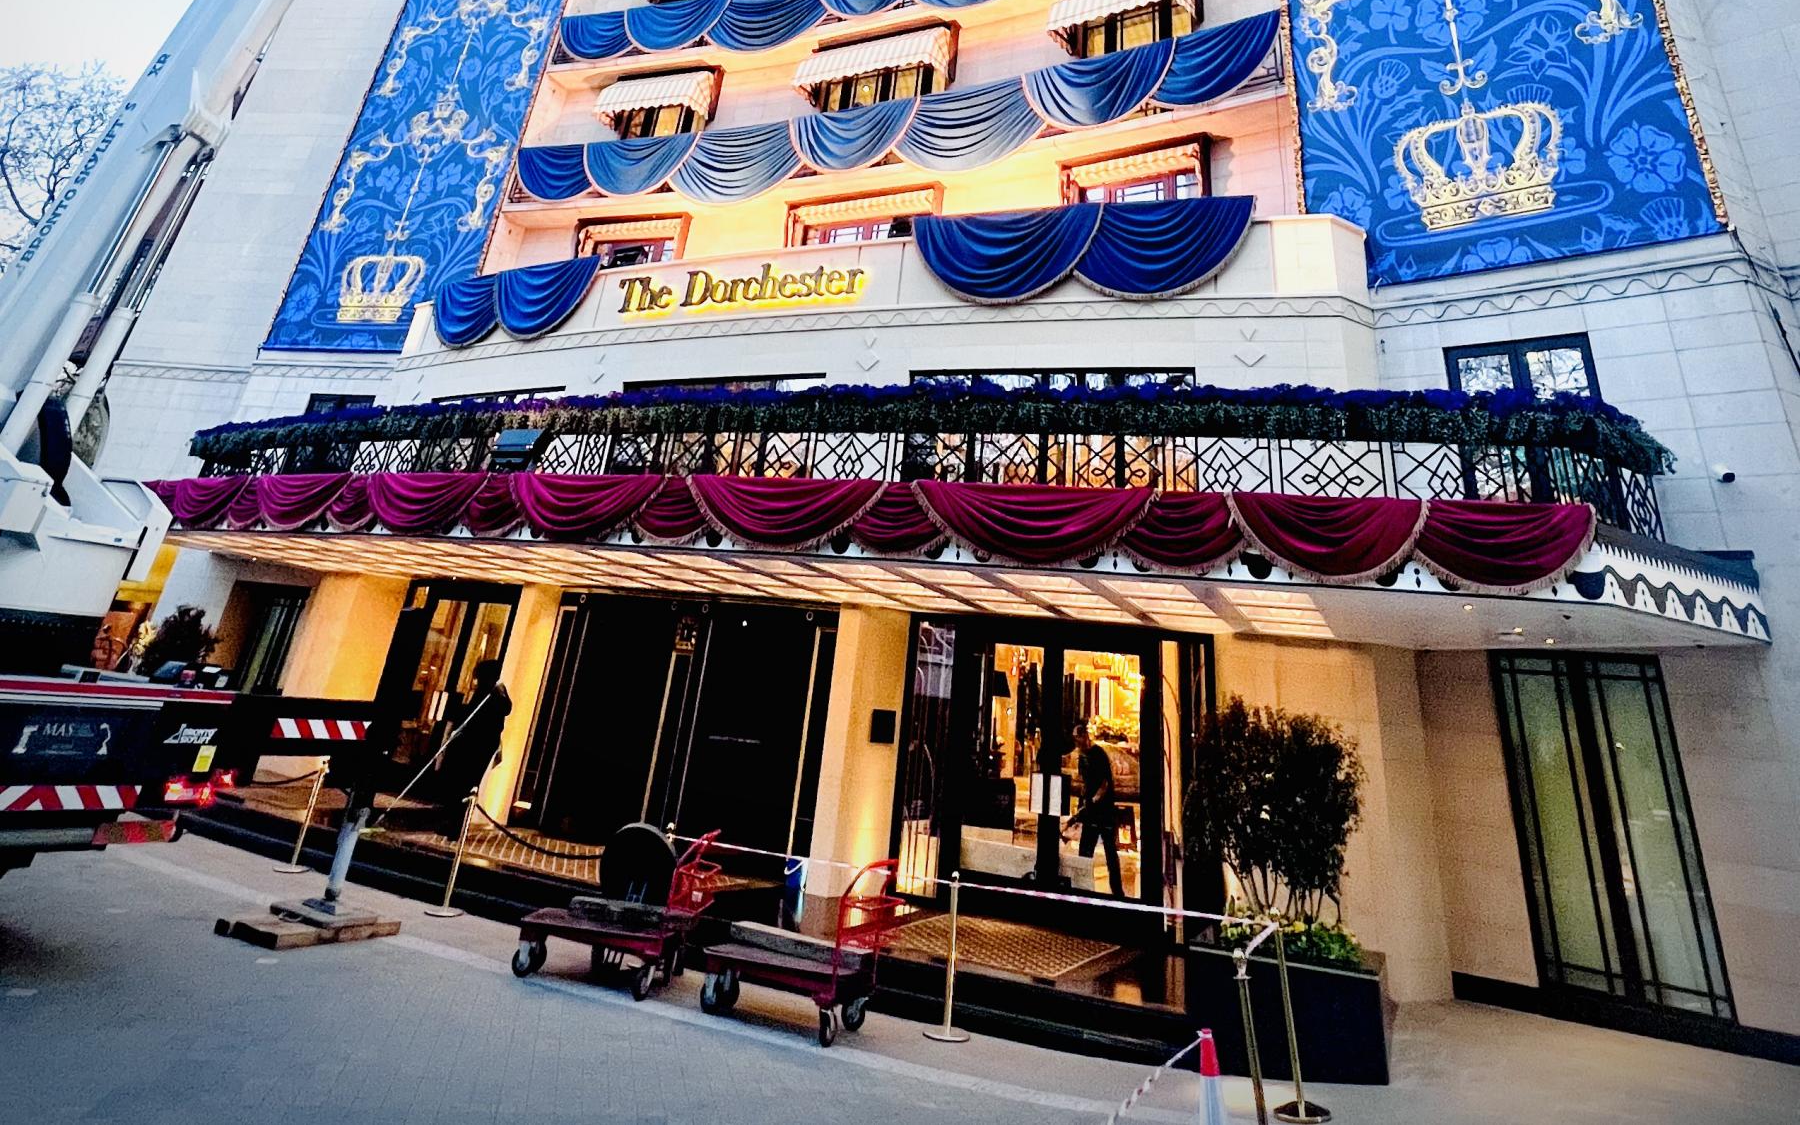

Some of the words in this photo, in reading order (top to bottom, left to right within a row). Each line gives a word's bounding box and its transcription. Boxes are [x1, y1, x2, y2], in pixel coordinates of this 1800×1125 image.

[20, 189, 77, 264] BRONTO
[74, 118, 124, 186] SKYLIFT
[617, 276, 673, 313] The
[679, 262, 864, 307] Dorchester
